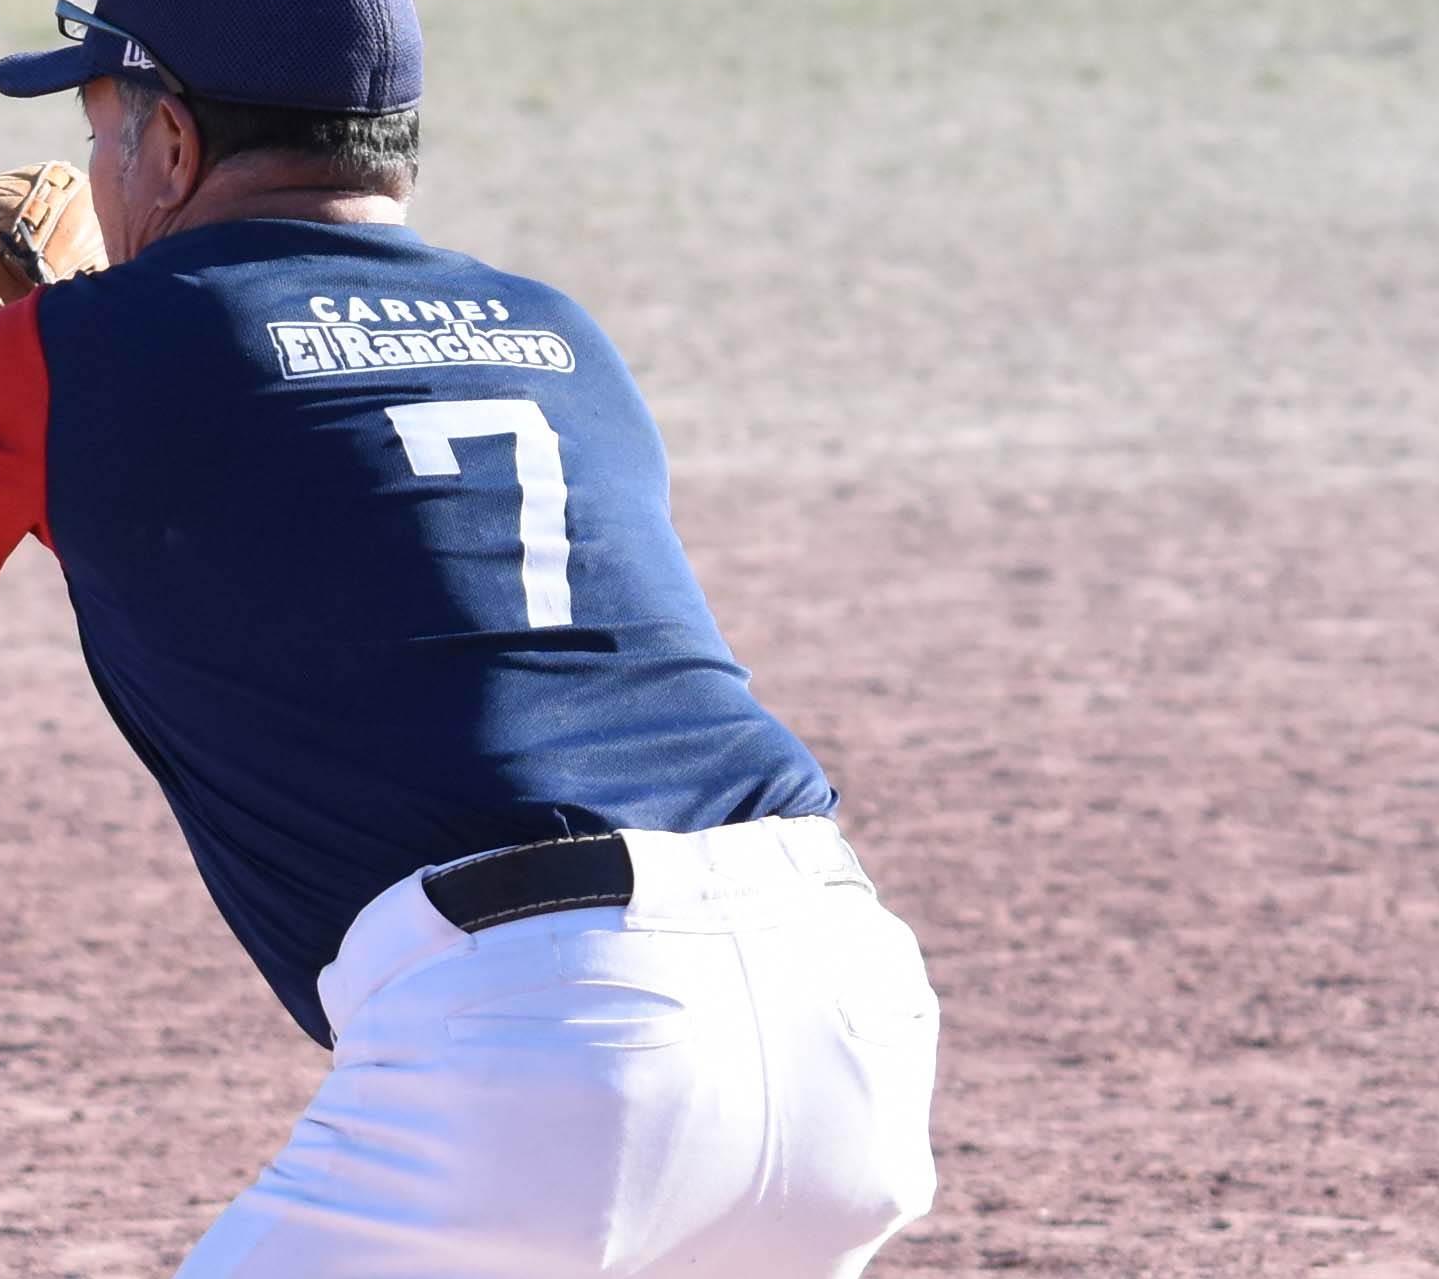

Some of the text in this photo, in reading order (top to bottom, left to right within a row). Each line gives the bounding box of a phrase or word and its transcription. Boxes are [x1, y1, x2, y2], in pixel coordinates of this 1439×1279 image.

[309, 296, 510, 322] CARNES
[276, 322, 571, 373] El Ranchero
[384, 398, 573, 629] 7
